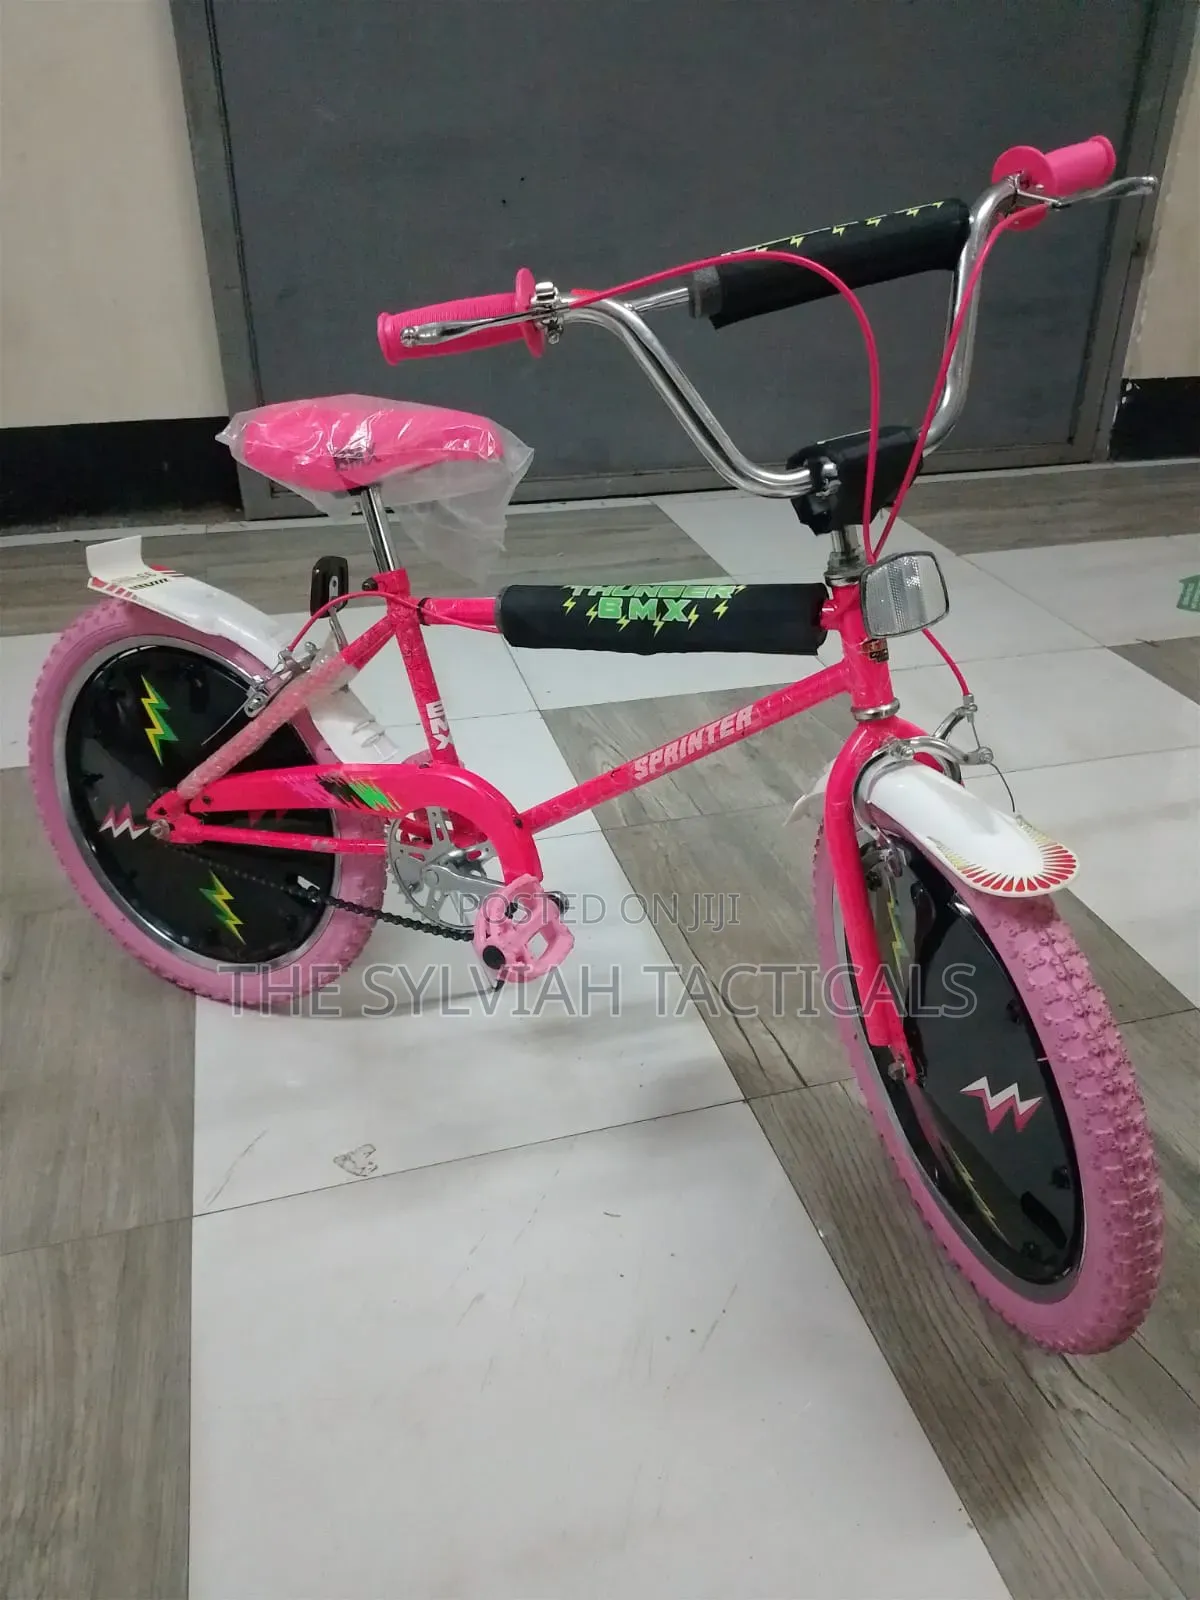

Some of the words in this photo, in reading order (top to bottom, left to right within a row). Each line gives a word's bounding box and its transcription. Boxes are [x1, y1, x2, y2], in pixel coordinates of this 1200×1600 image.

[570, 584, 737, 599] THUNDER
[597, 596, 692, 623] BMX
[633, 704, 754, 781] SPRINTER
